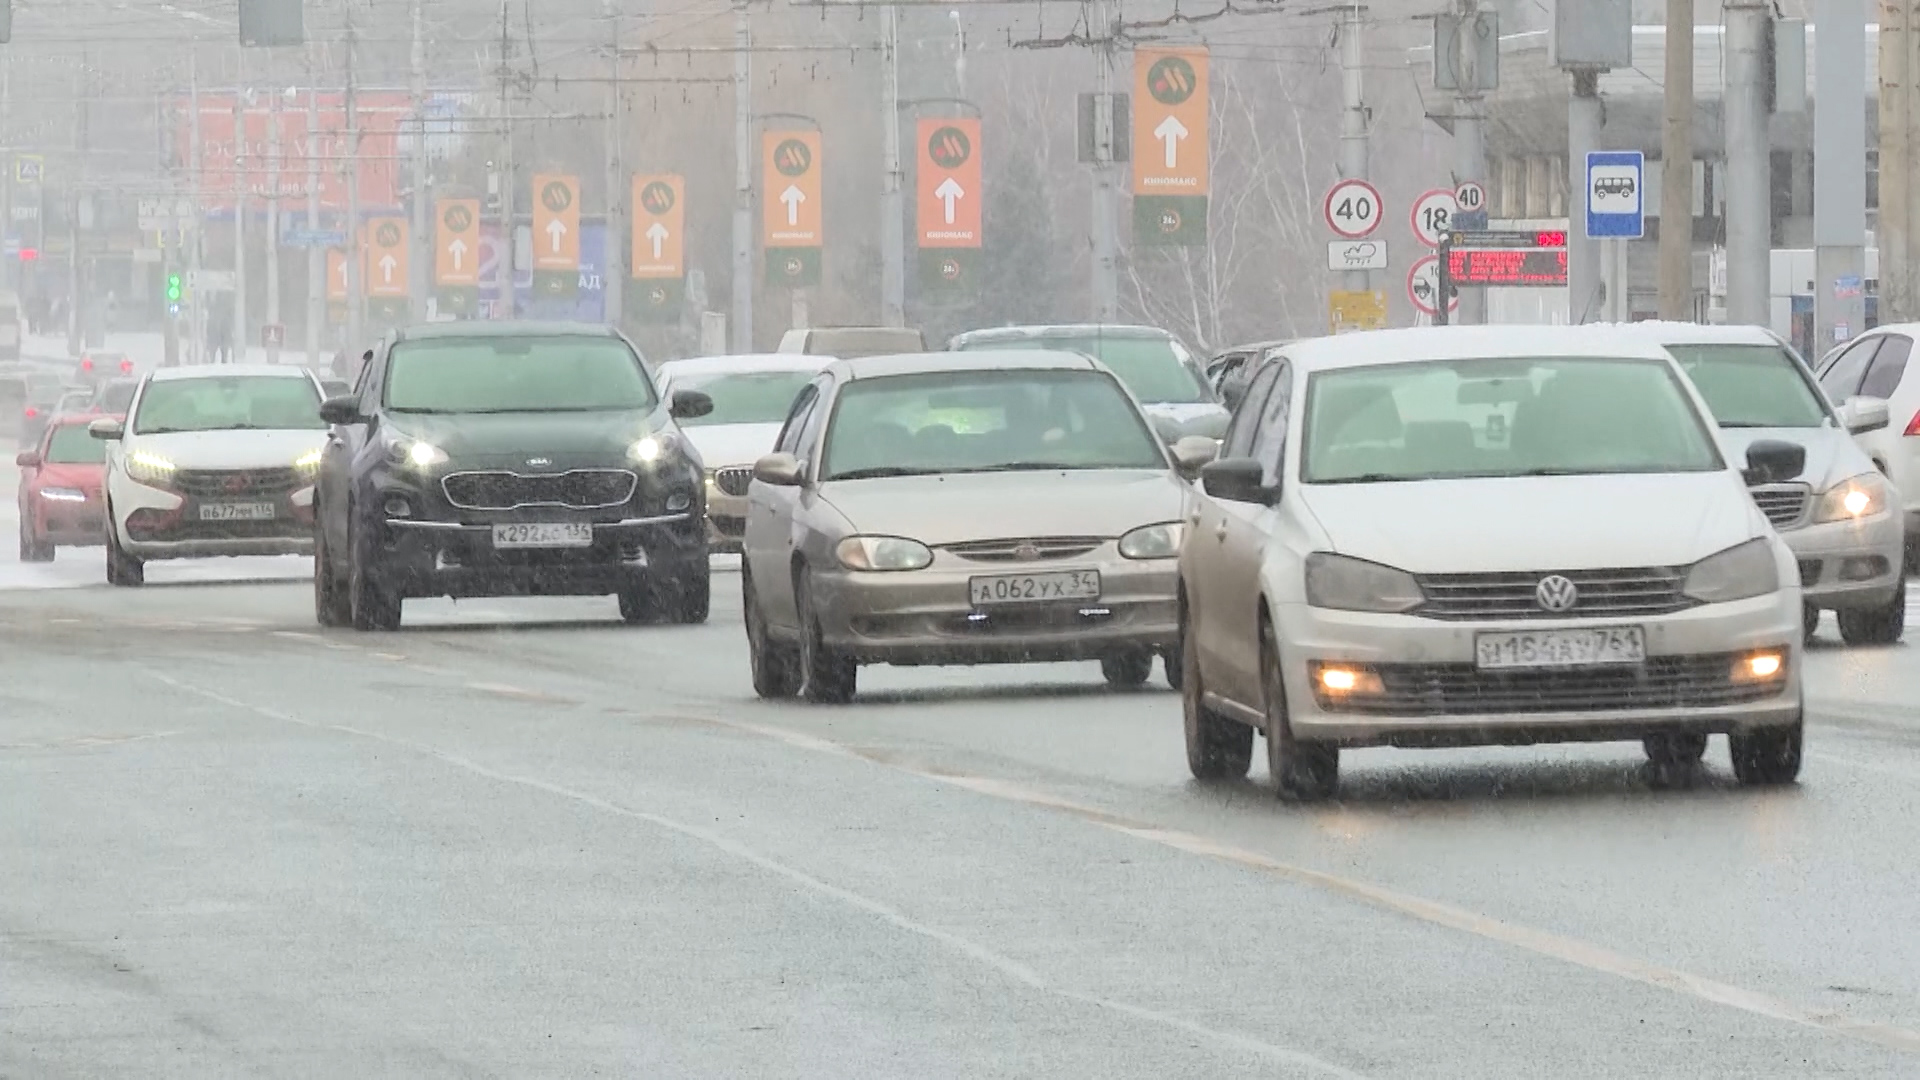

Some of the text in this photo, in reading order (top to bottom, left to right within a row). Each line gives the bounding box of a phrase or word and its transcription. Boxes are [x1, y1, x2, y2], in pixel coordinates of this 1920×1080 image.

[1143, 177, 1198, 186] КИНОМАКС
[1458, 187, 1479, 207] 40
[1335, 197, 1371, 220] 40
[1423, 207, 1448, 230] 18
